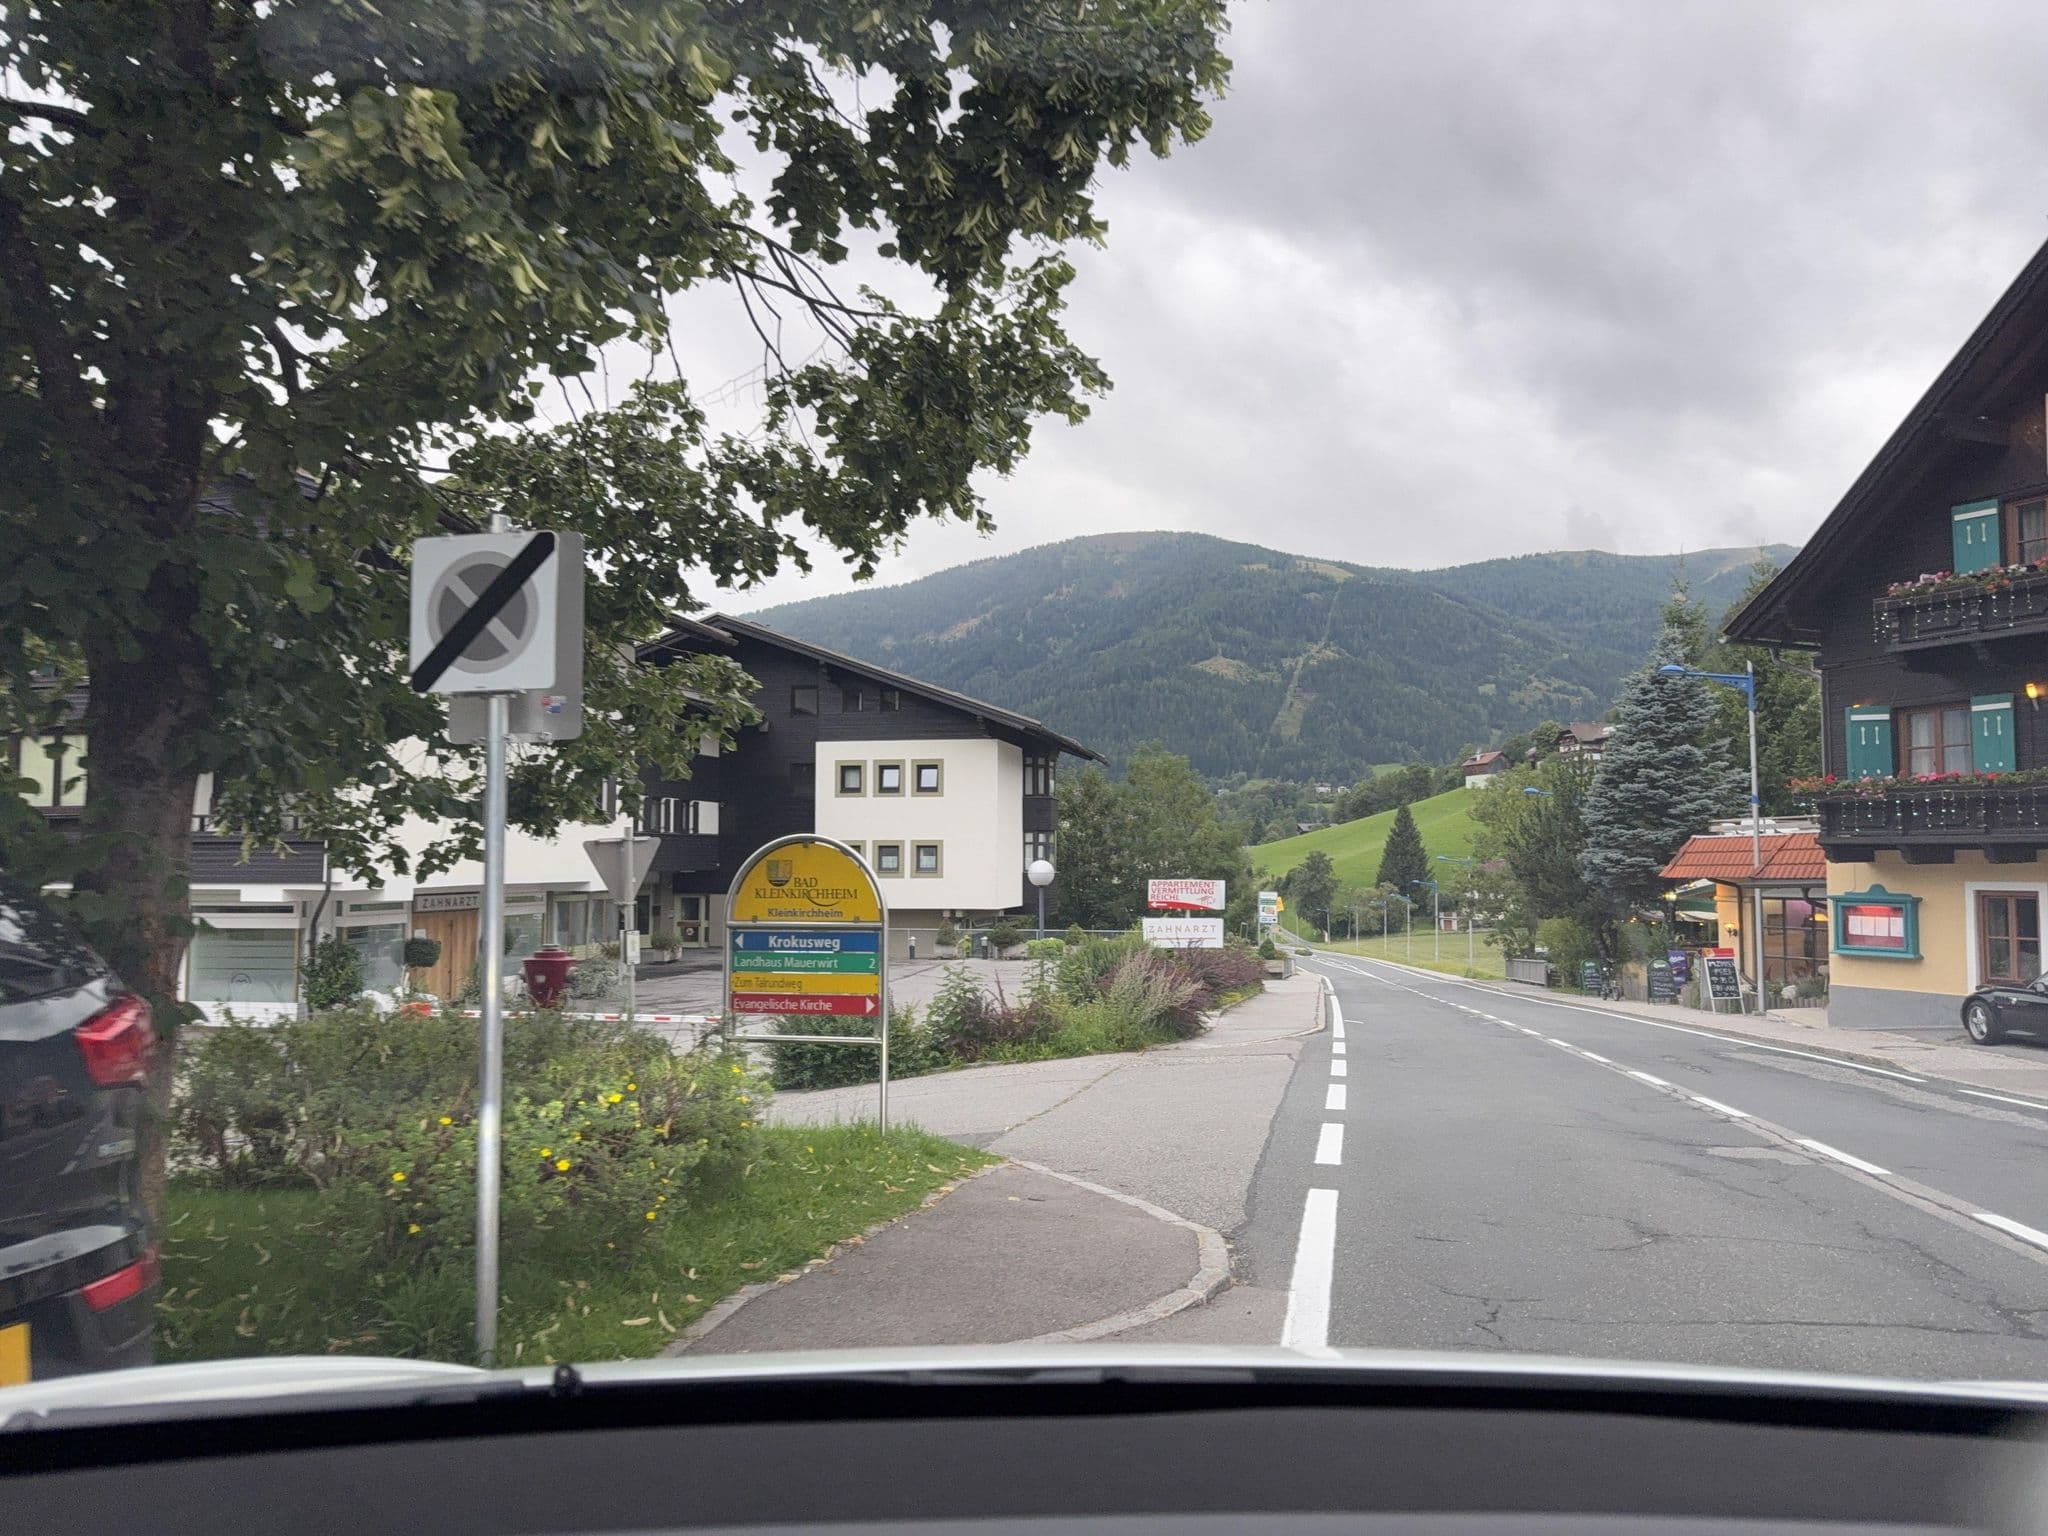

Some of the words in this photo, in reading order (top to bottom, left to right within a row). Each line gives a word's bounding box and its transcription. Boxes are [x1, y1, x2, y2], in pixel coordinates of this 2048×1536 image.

[793, 877, 818, 888] BAD
[754, 888, 858, 900] KLEINKIRCHHEIM
[422, 896, 479, 909] ZAHNARZT
[767, 907, 844, 918] Kleinkirchheim
[1148, 924, 1217, 934] ZAHNARZT
[768, 935, 841, 951] Krokusweg
[734, 957, 783, 968] Landhaus
[784, 957, 838, 968] Mauerwirt
[868, 958, 876, 969] 2
[733, 998, 799, 1012] Evangelische
[800, 999, 833, 1010] Kirche
